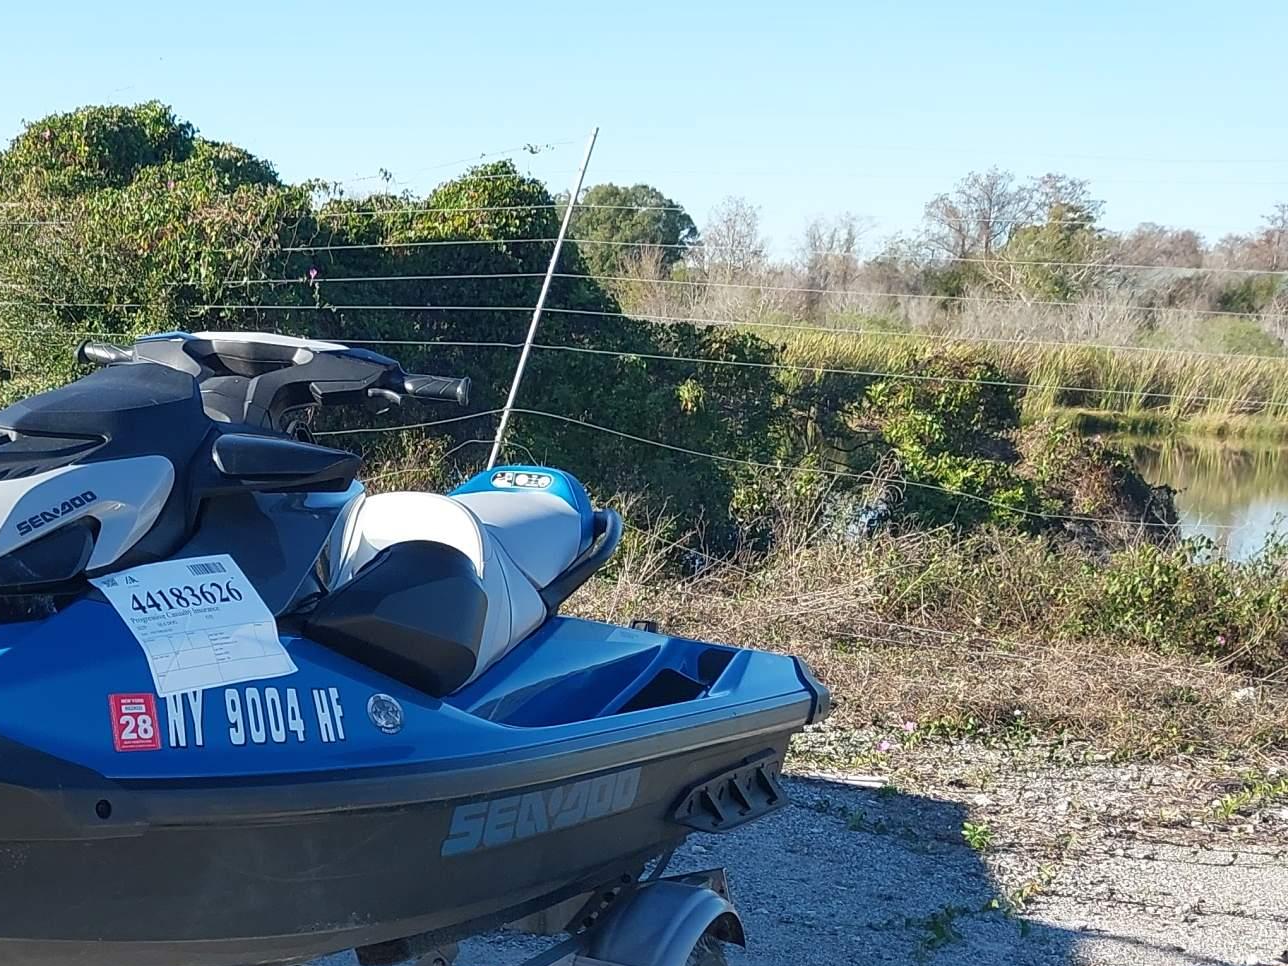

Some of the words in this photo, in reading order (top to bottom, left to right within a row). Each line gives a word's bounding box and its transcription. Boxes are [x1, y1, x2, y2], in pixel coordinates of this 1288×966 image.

[130, 579, 243, 615] 44183626
[119, 714, 154, 740] 28
[166, 689, 203, 747] NY
[224, 687, 305, 746] 9004
[312, 687, 345, 743] HF
